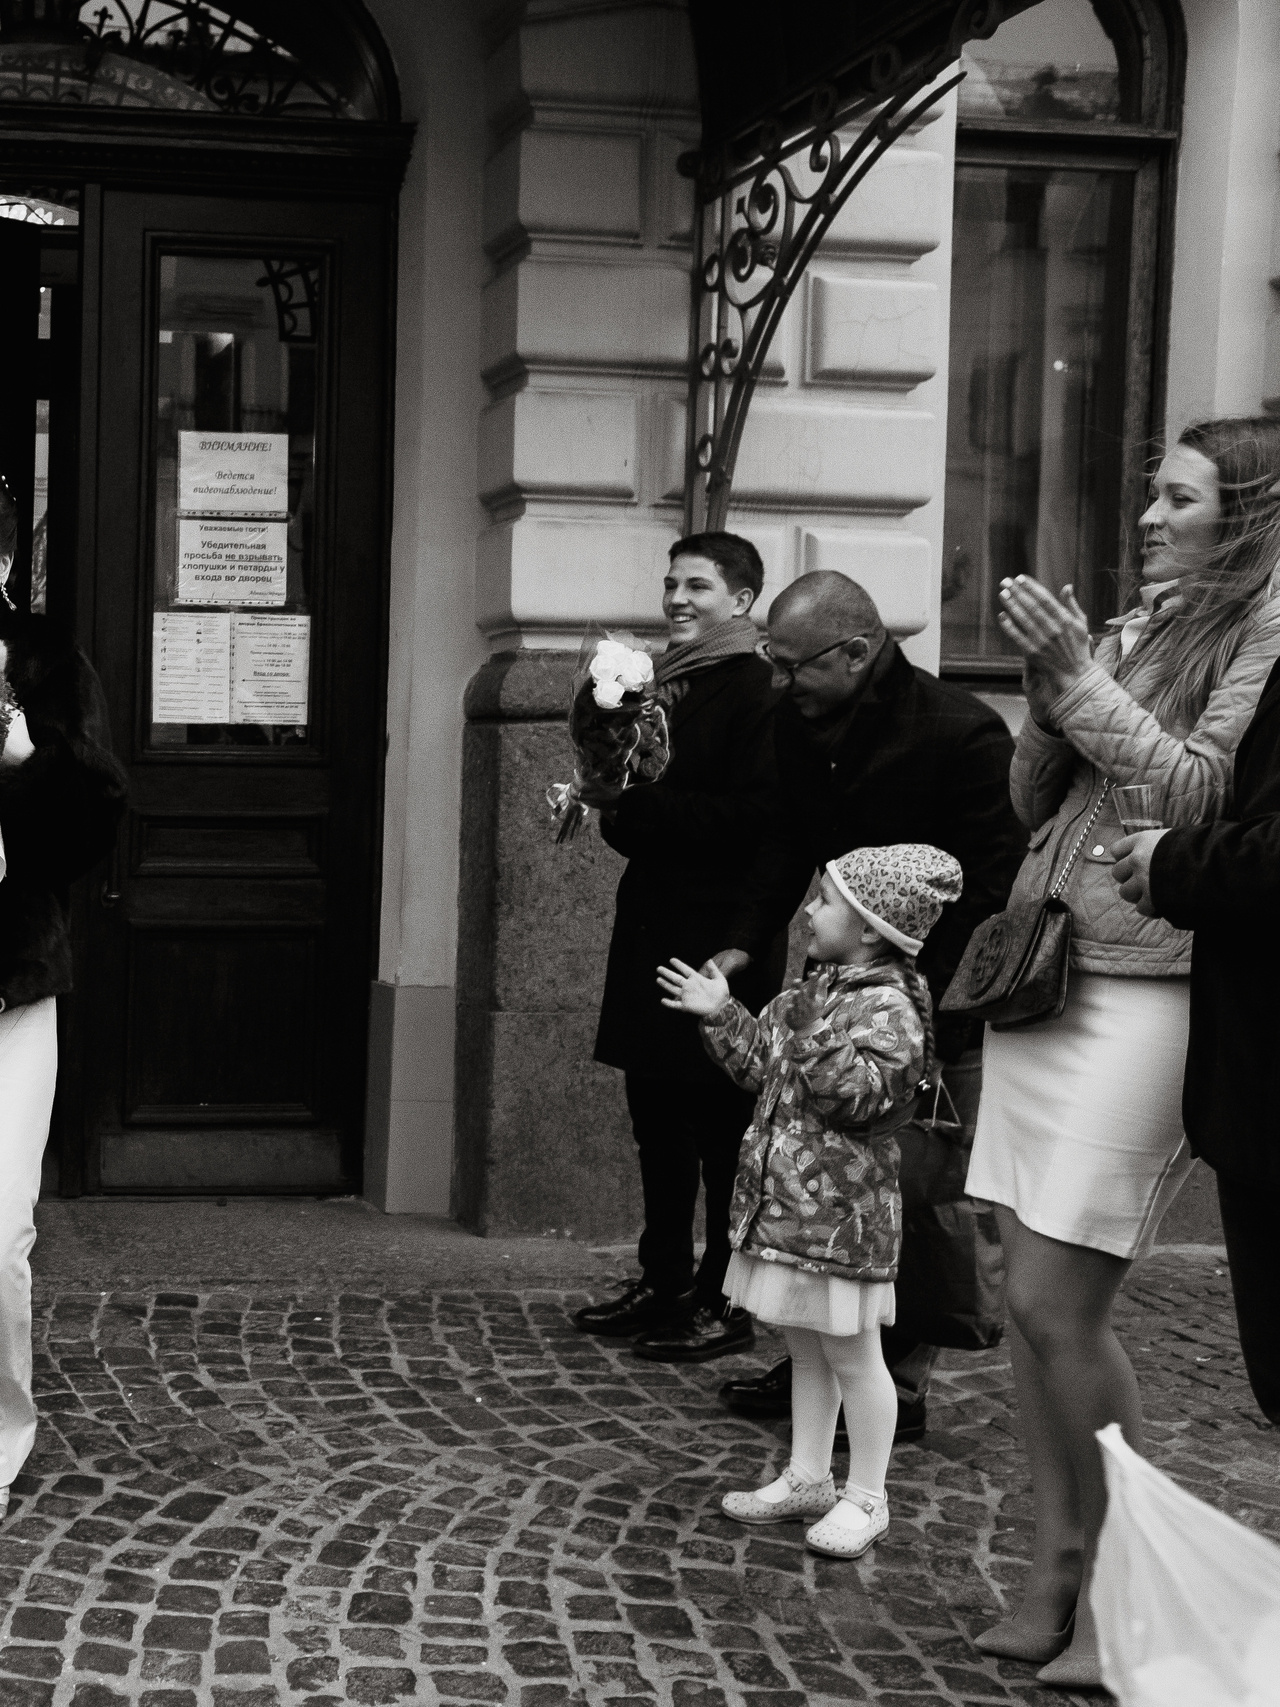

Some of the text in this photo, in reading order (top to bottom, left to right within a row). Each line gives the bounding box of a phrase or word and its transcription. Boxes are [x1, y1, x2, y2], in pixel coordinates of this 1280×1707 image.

[199, 441, 272, 452] ВНИМАНИЕ!
[215, 470, 255, 480] Ведется
[193, 484, 277, 495] видеонаблюдение!
[199, 524, 244, 532] Уважаемые
[201, 541, 267, 550] Убедительная
[184, 552, 223, 560] просьба
[238, 554, 283, 562] взрывать
[182, 563, 227, 572] хлопушки
[237, 564, 278, 573] петарды
[280, 565, 286, 574] у
[194, 574, 222, 582] входа
[237, 575, 273, 584] дворец
